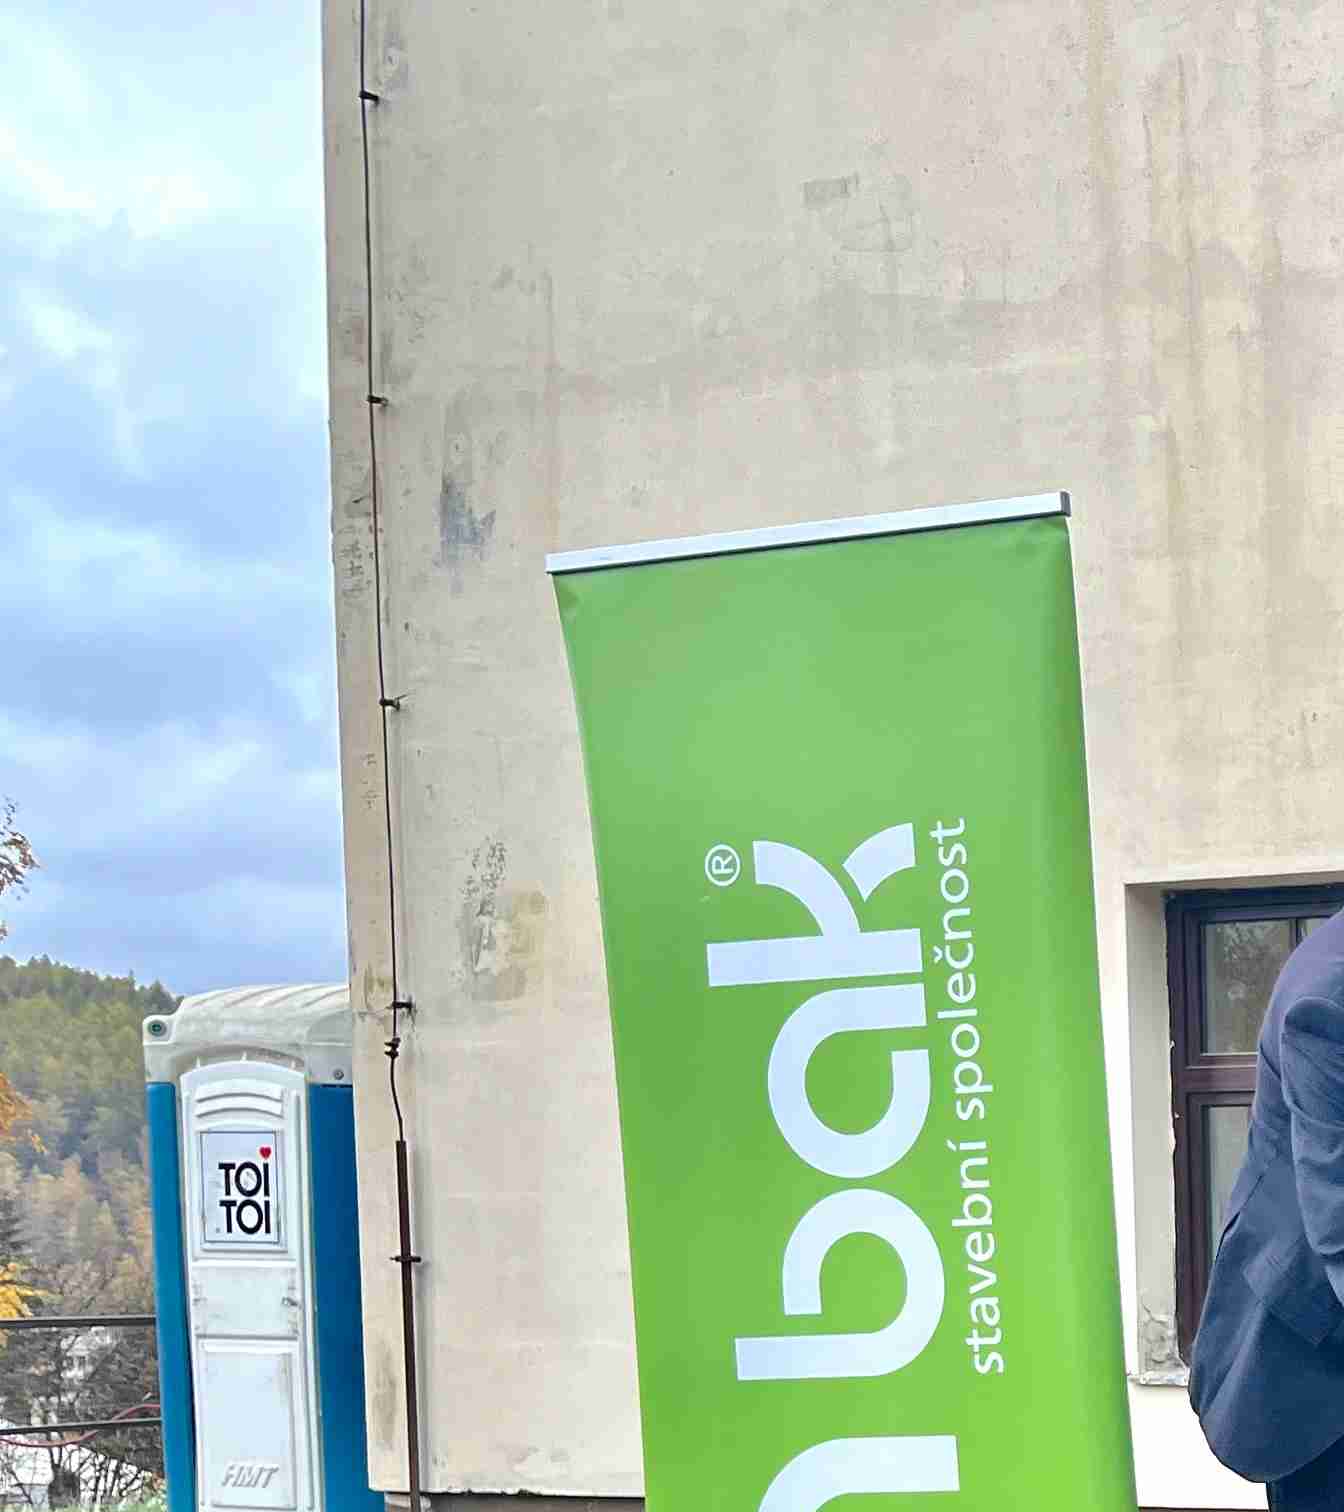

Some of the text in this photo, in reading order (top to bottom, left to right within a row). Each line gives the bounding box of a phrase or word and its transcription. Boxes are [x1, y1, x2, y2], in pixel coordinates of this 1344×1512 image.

[929, 817, 1004, 1375] stavební společnost
[218, 1161, 270, 1197] TOI
[219, 1198, 271, 1235] TOI
